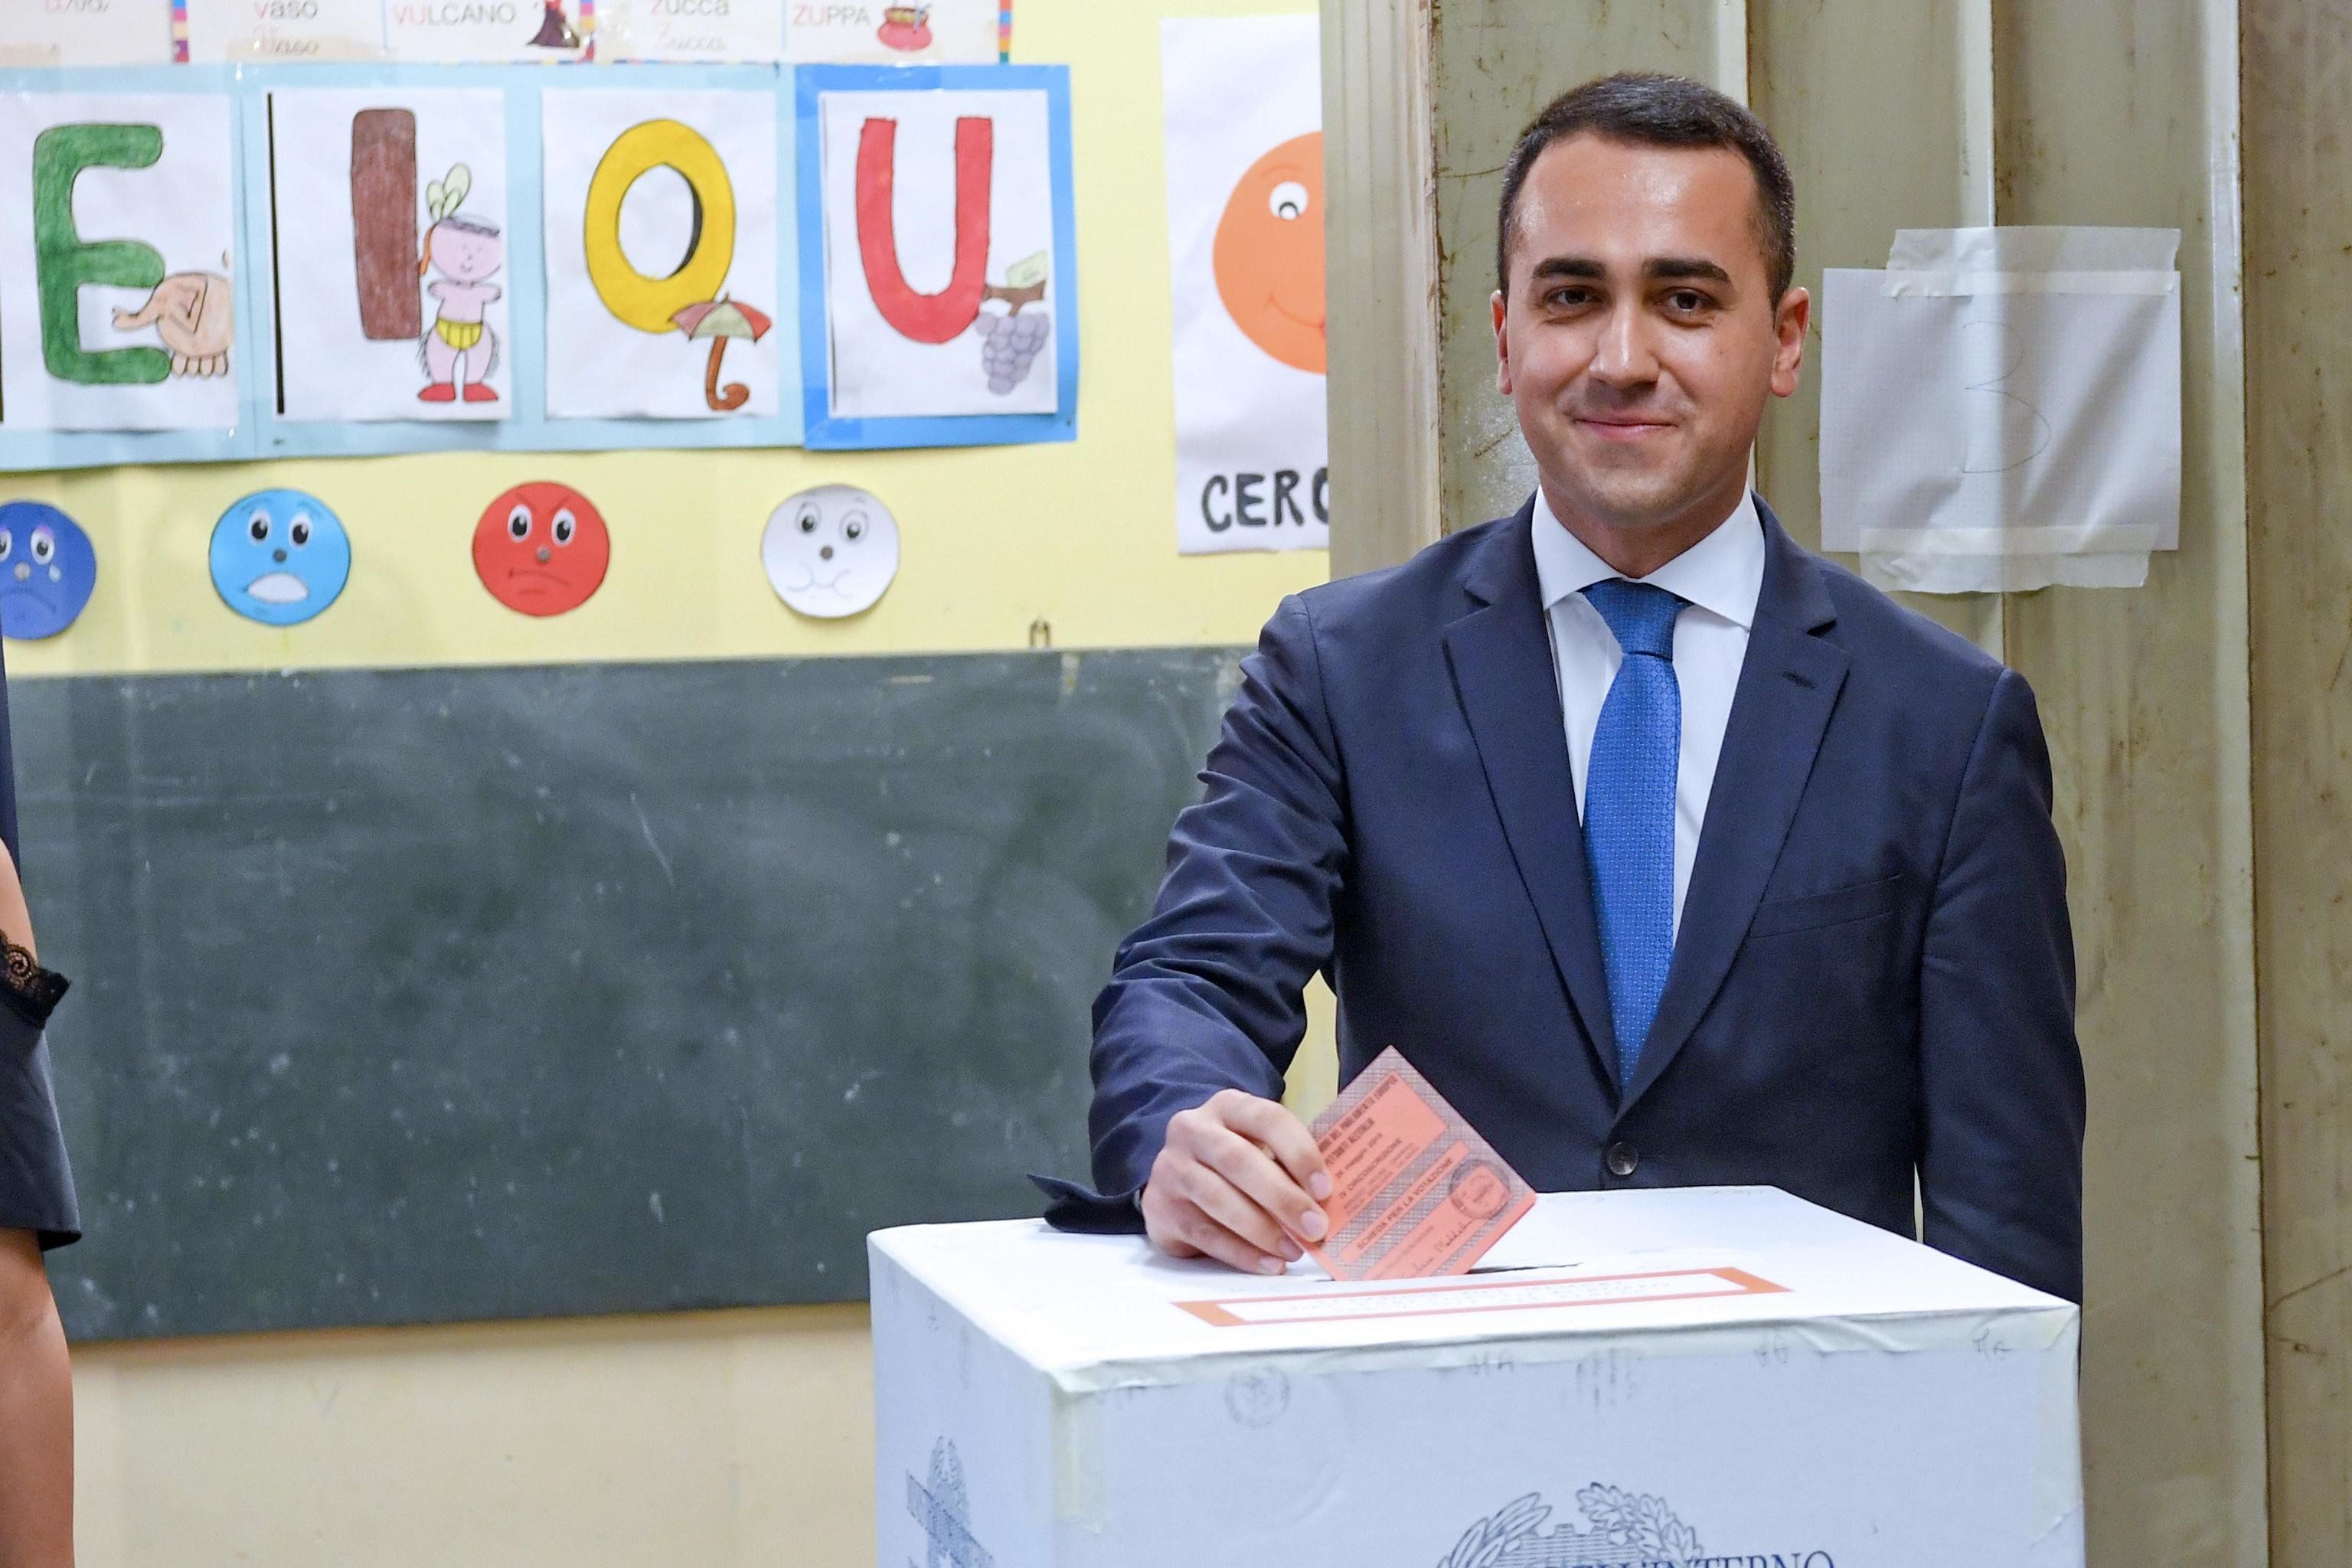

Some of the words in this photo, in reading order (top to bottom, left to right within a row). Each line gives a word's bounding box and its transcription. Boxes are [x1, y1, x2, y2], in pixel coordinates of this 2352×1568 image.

[394, 2, 517, 26] VULCANO
[792, 4, 871, 26] ZUPPA
[32, 121, 172, 387] E
[350, 107, 423, 341] I
[855, 115, 993, 345] U
[1355, 1219, 1387, 1250] SCHEDA
[1386, 1204, 1404, 1221] PER
[1401, 1194, 1414, 1207] LA
[1411, 1156, 1454, 1197] VOTAZIONE
